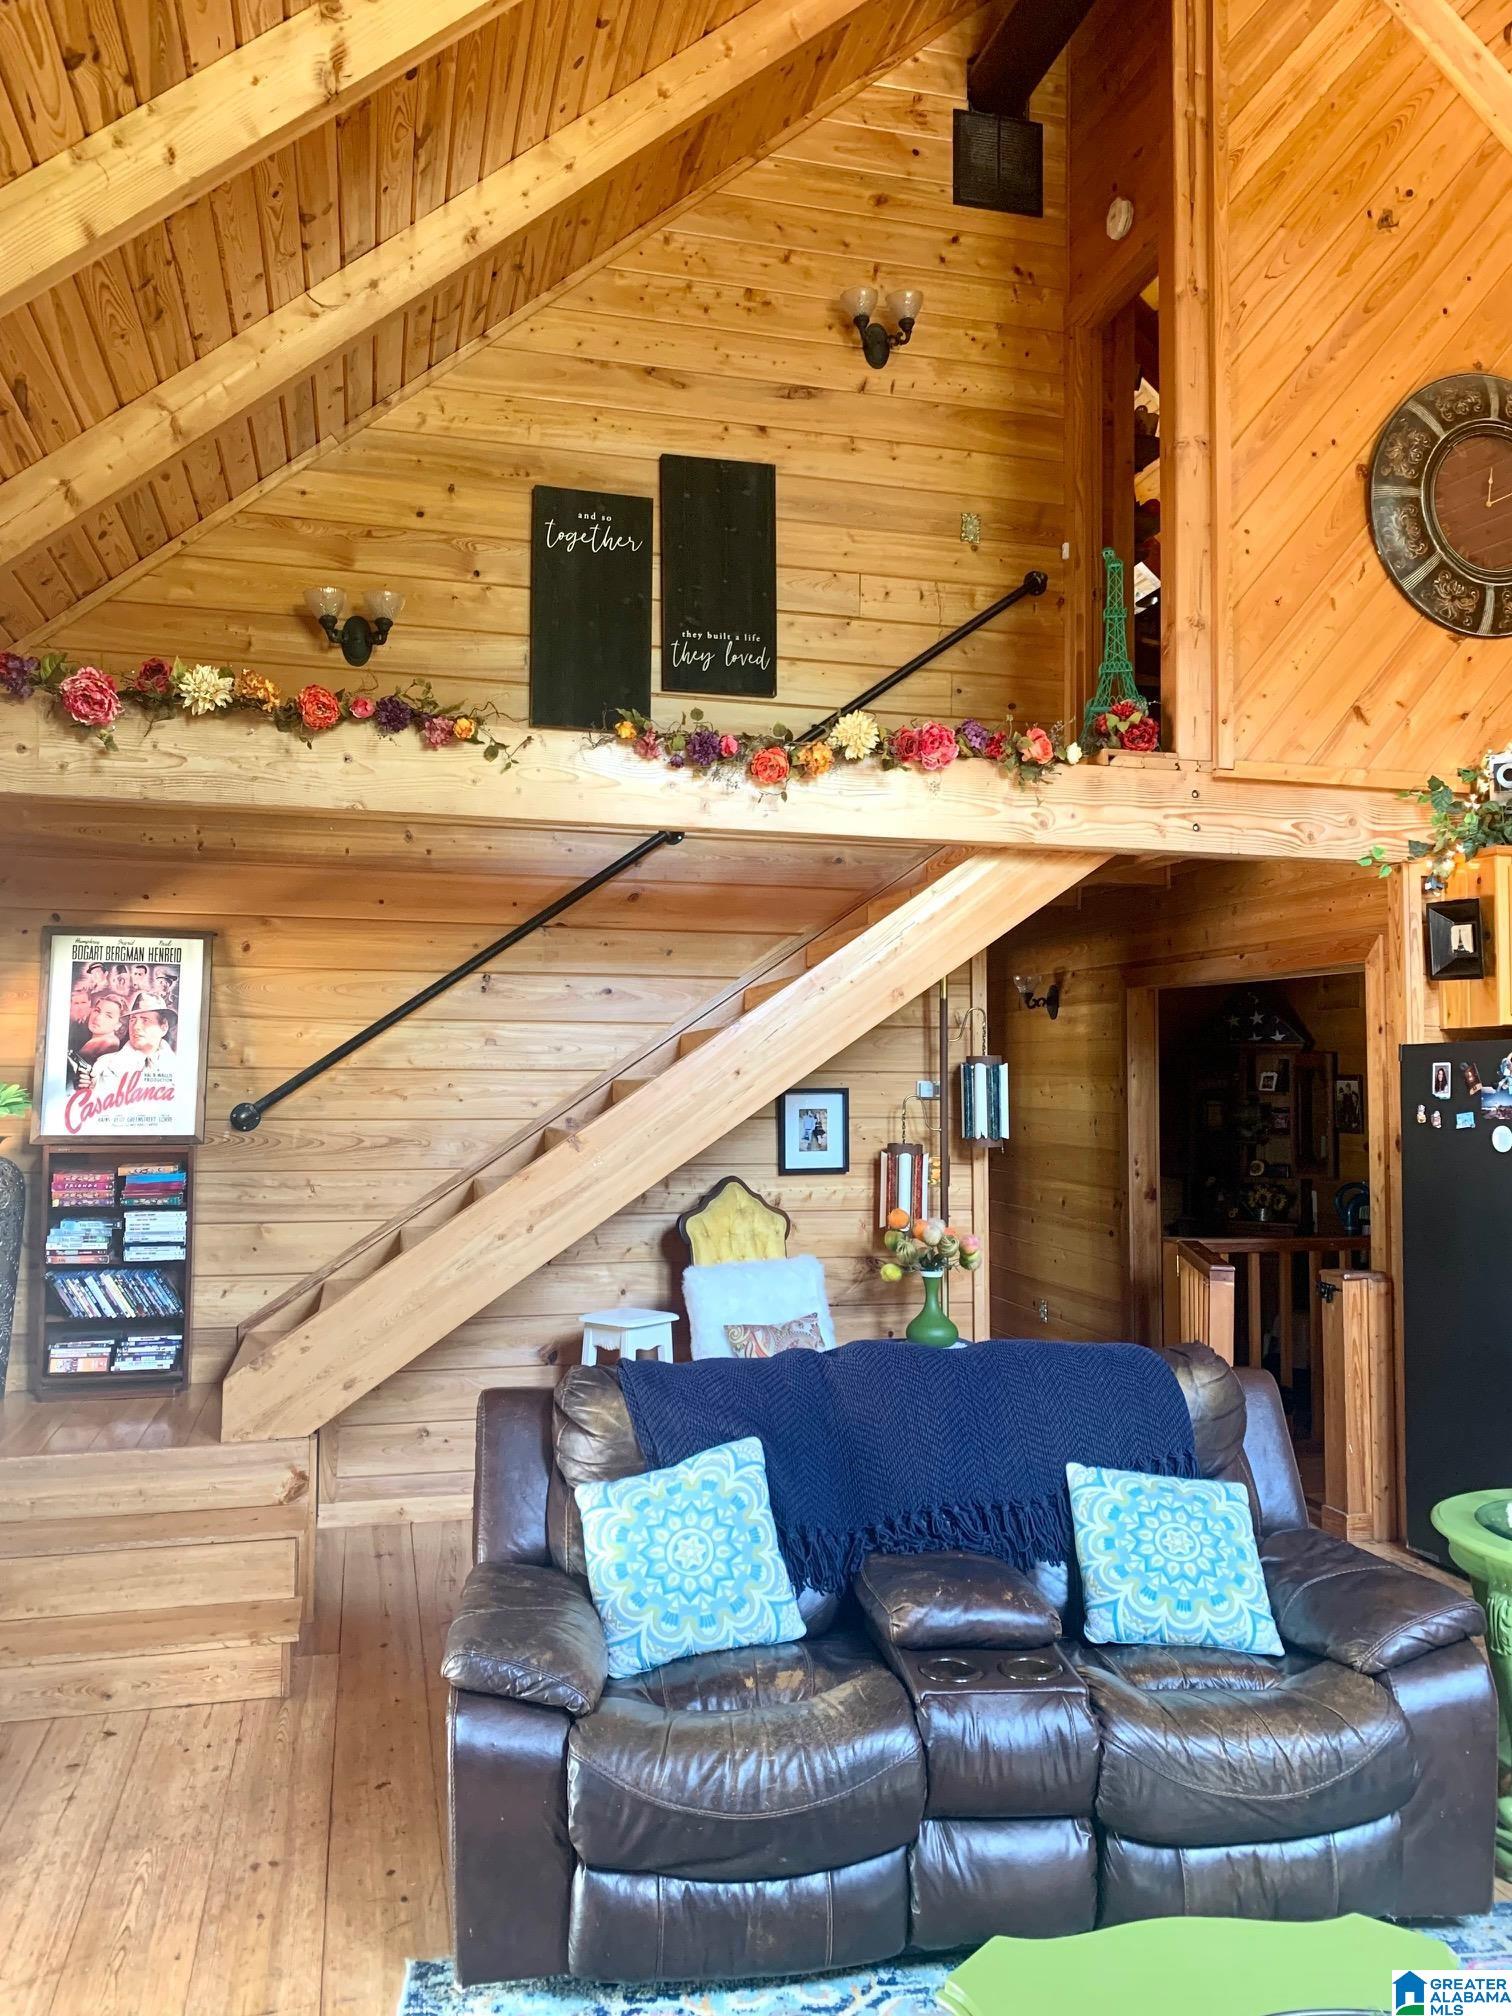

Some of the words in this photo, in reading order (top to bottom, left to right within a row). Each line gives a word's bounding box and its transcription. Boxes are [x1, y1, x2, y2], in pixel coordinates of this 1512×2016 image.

[577, 512, 596, 520] and
[544, 519, 643, 553] together
[681, 630, 703, 640] they
[706, 631, 731, 640] built
[744, 633, 761, 642] life
[670, 640, 716, 672] they
[725, 640, 771, 671] loved
[72, 945, 104, 961] BOGART
[105, 946, 145, 962] BERGMAN
[148, 947, 182, 963] HENREID
[64, 1071, 175, 1134] Casablanca
